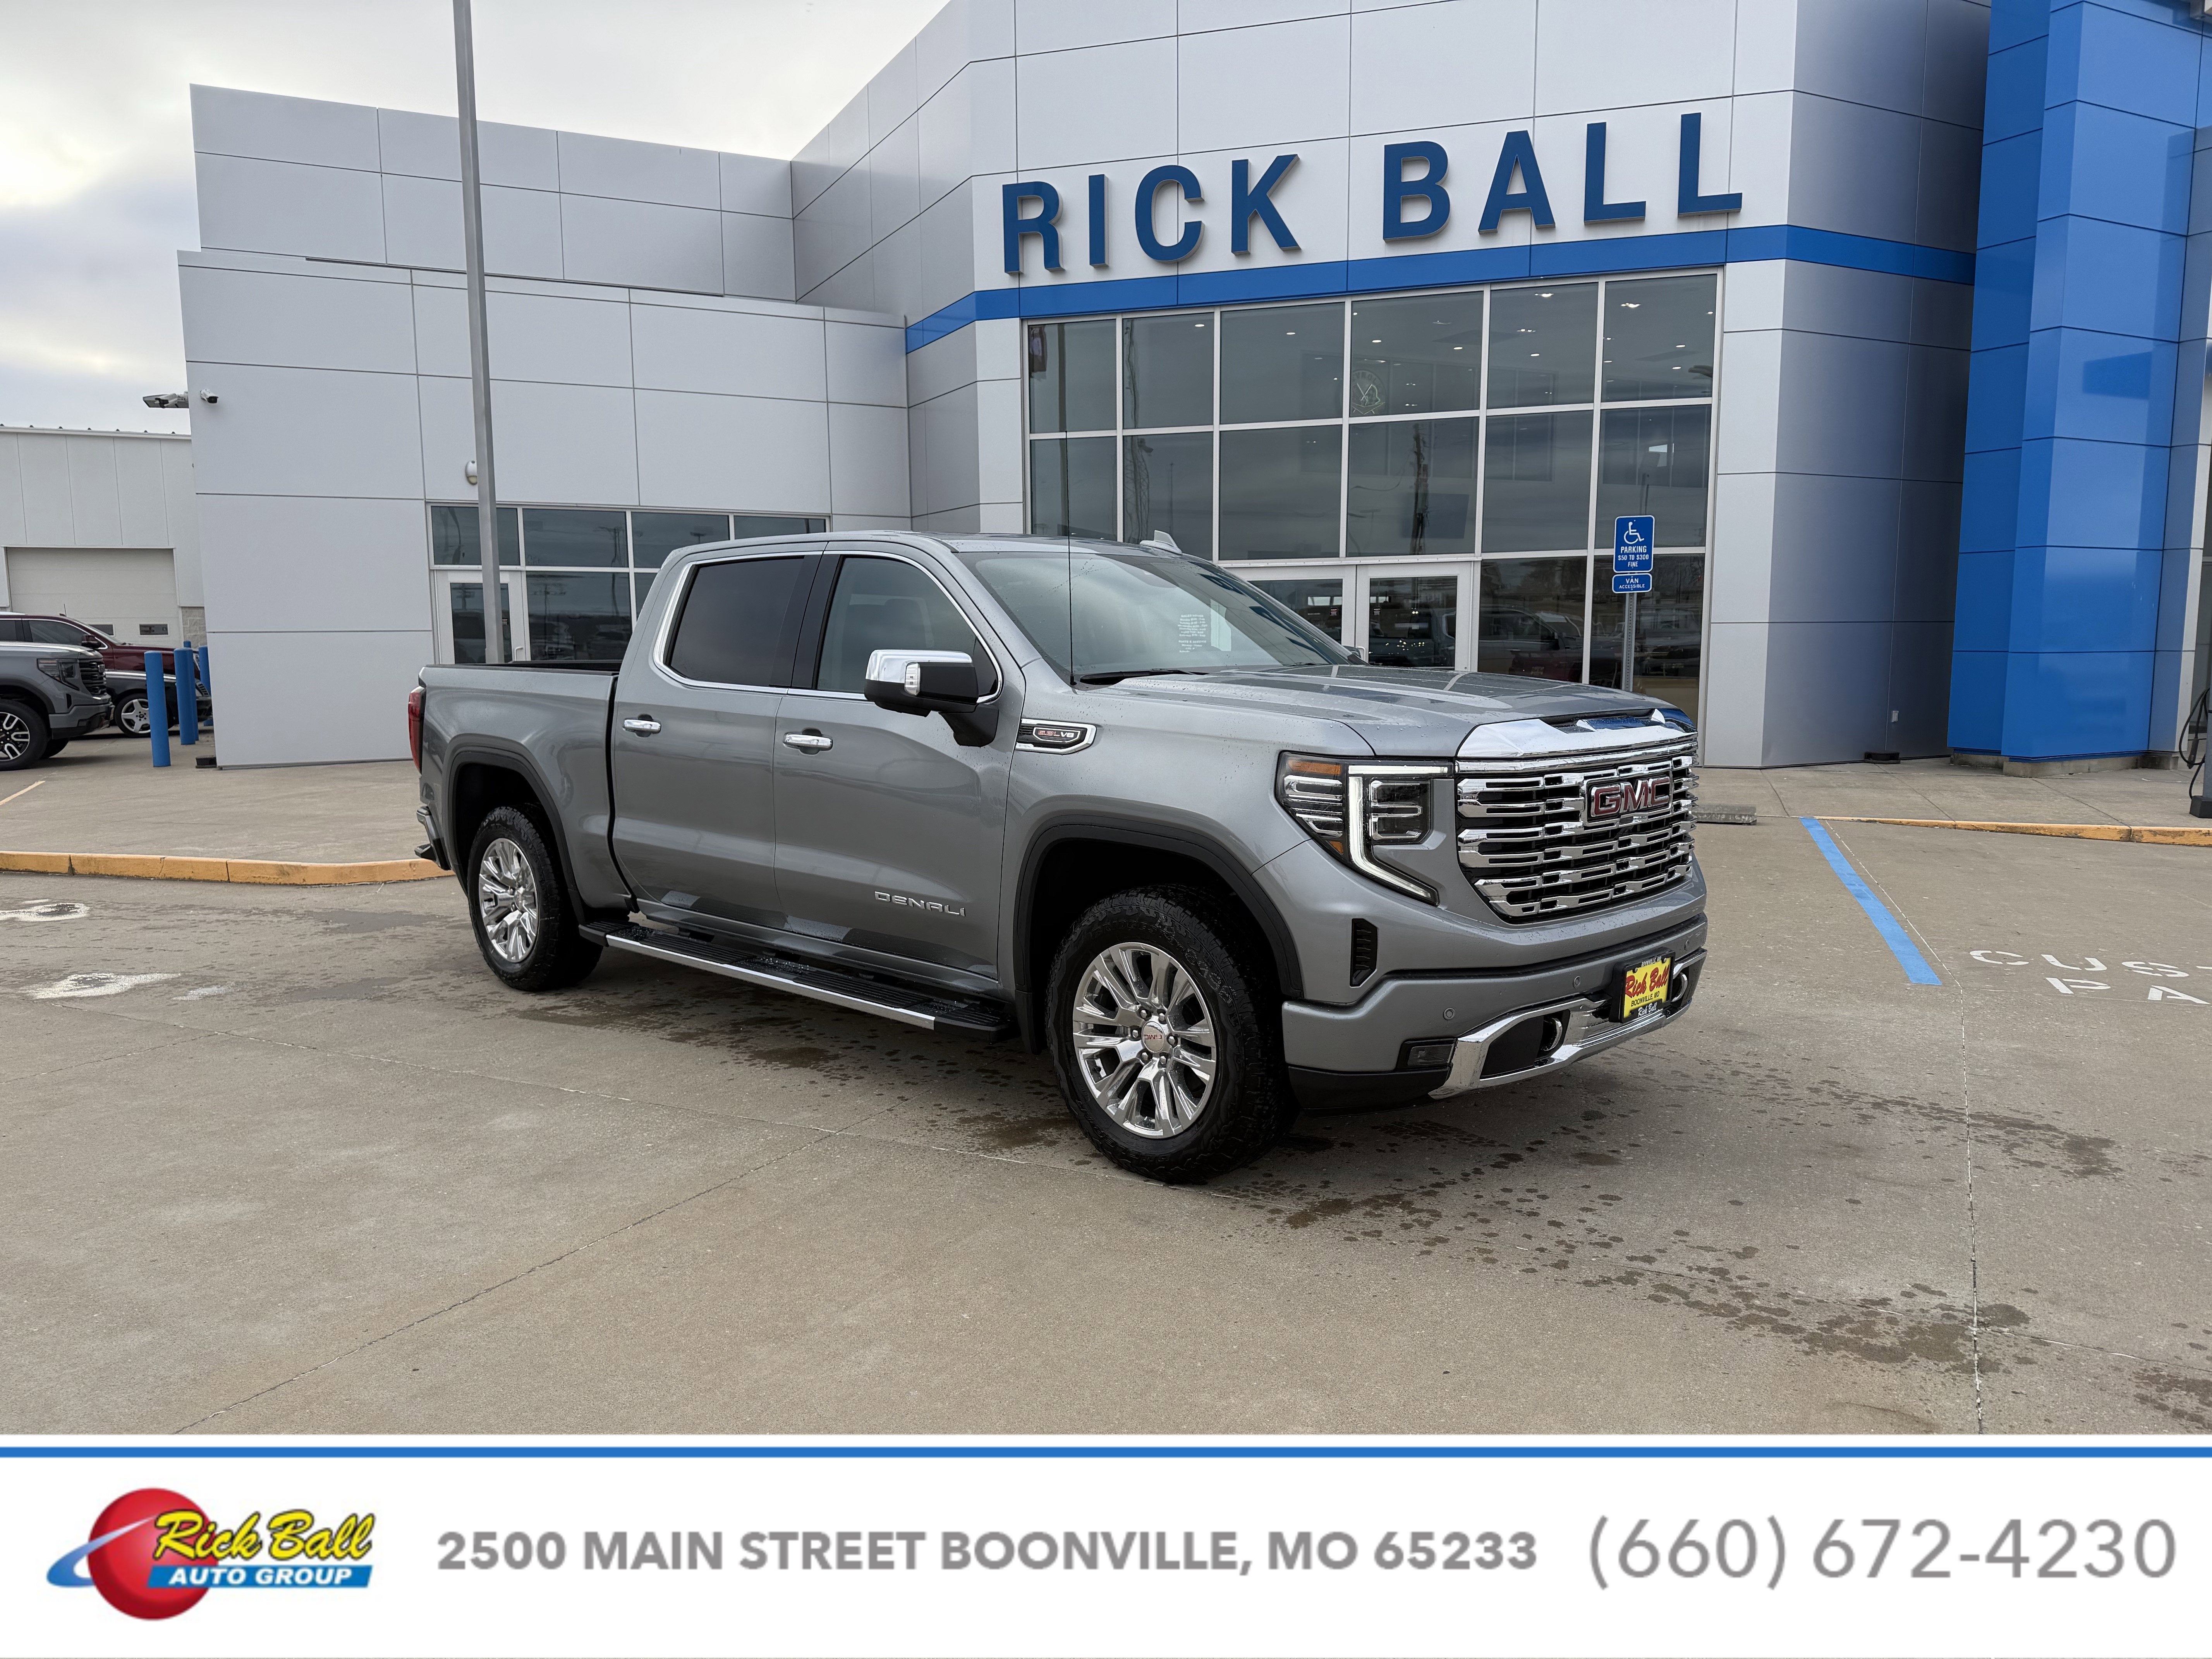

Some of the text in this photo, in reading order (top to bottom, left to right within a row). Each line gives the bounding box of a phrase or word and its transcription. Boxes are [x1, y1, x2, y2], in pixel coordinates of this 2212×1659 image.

[1002, 112, 1742, 275] RICK BALL
[1591, 776, 1670, 817] GMC
[875, 891, 966, 917] DENALI
[1970, 950, 2212, 977] CUS
[1625, 964, 1669, 998] Rick Ball
[1638, 1002, 1657, 1017] Rick Ball
